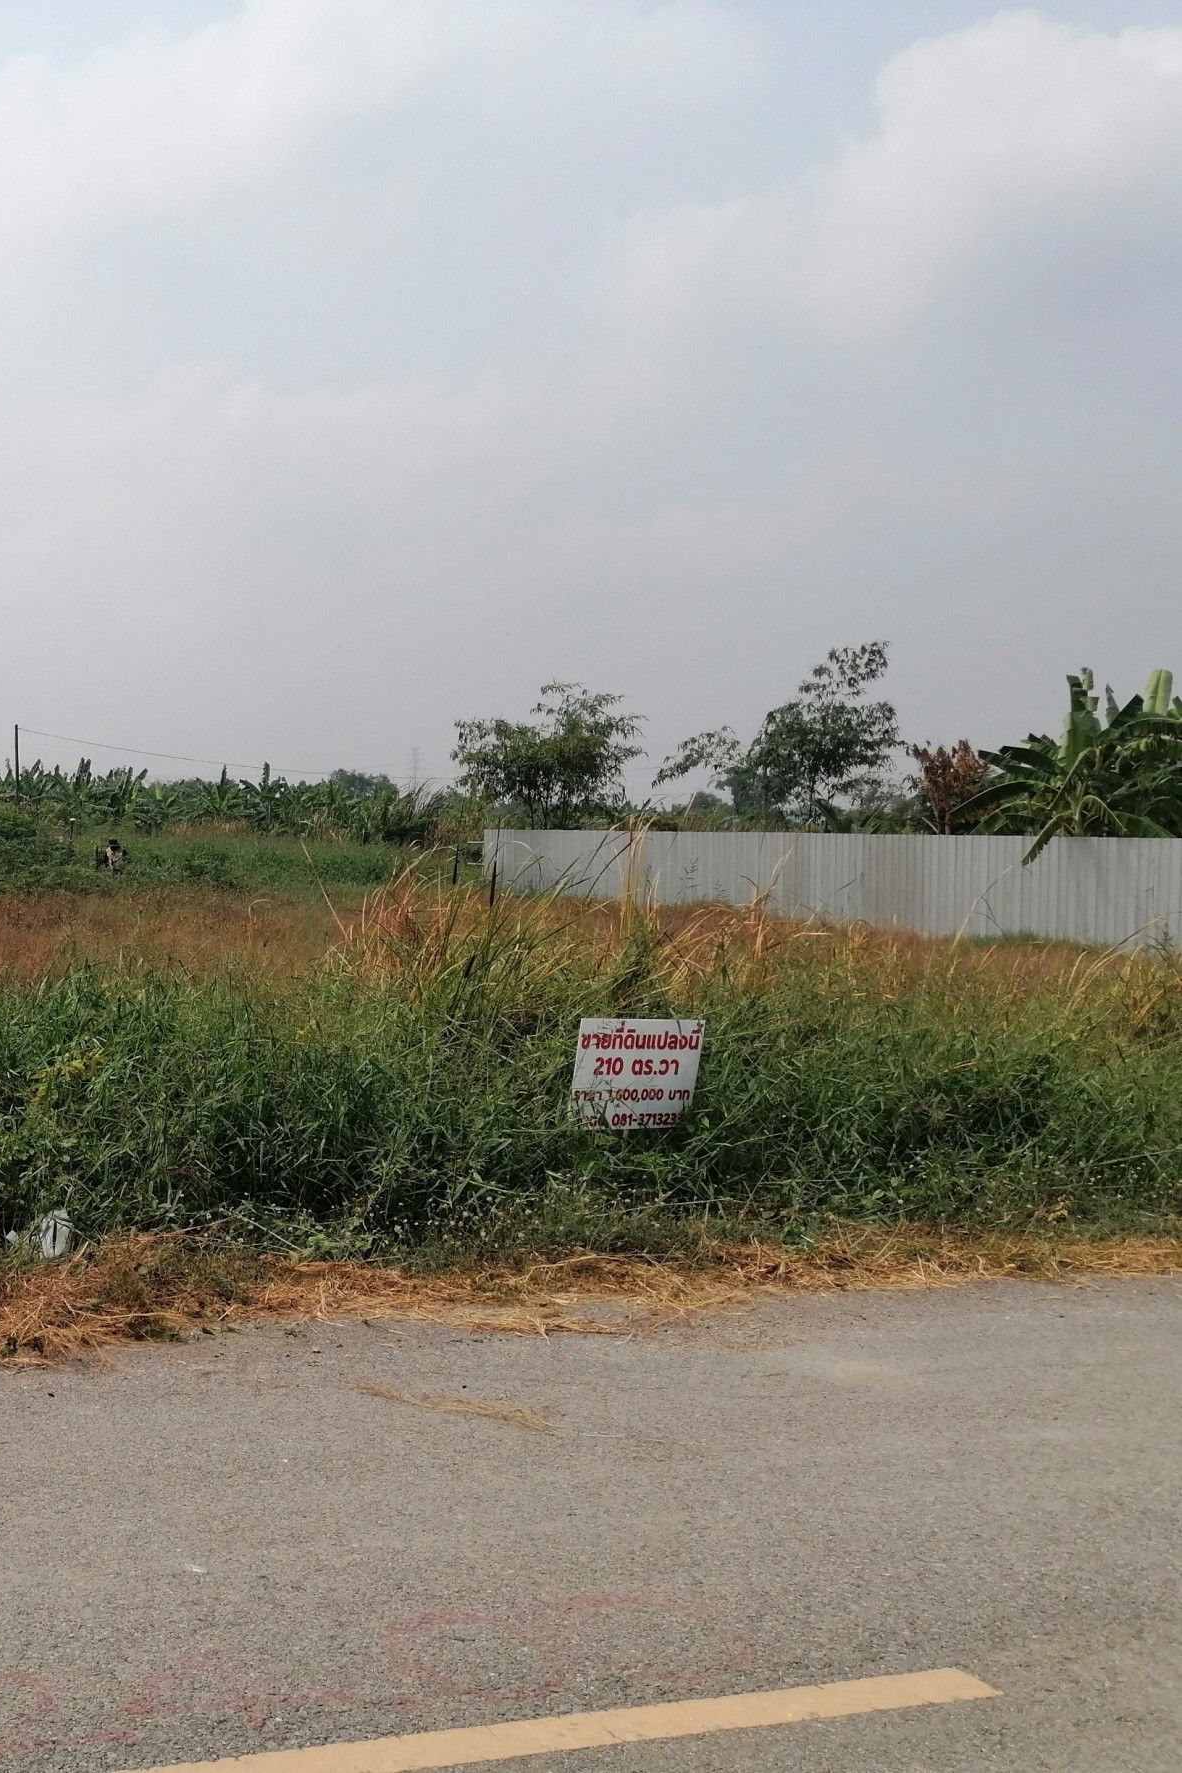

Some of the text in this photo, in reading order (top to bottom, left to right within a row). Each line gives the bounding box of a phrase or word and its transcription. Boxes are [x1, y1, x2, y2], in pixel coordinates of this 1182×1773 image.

[581, 1020, 704, 1050] ขายที่ดินแปลงนี้
[593, 1057, 680, 1076] 210 ตร.วา
[668, 1089, 691, 1101] บาท
